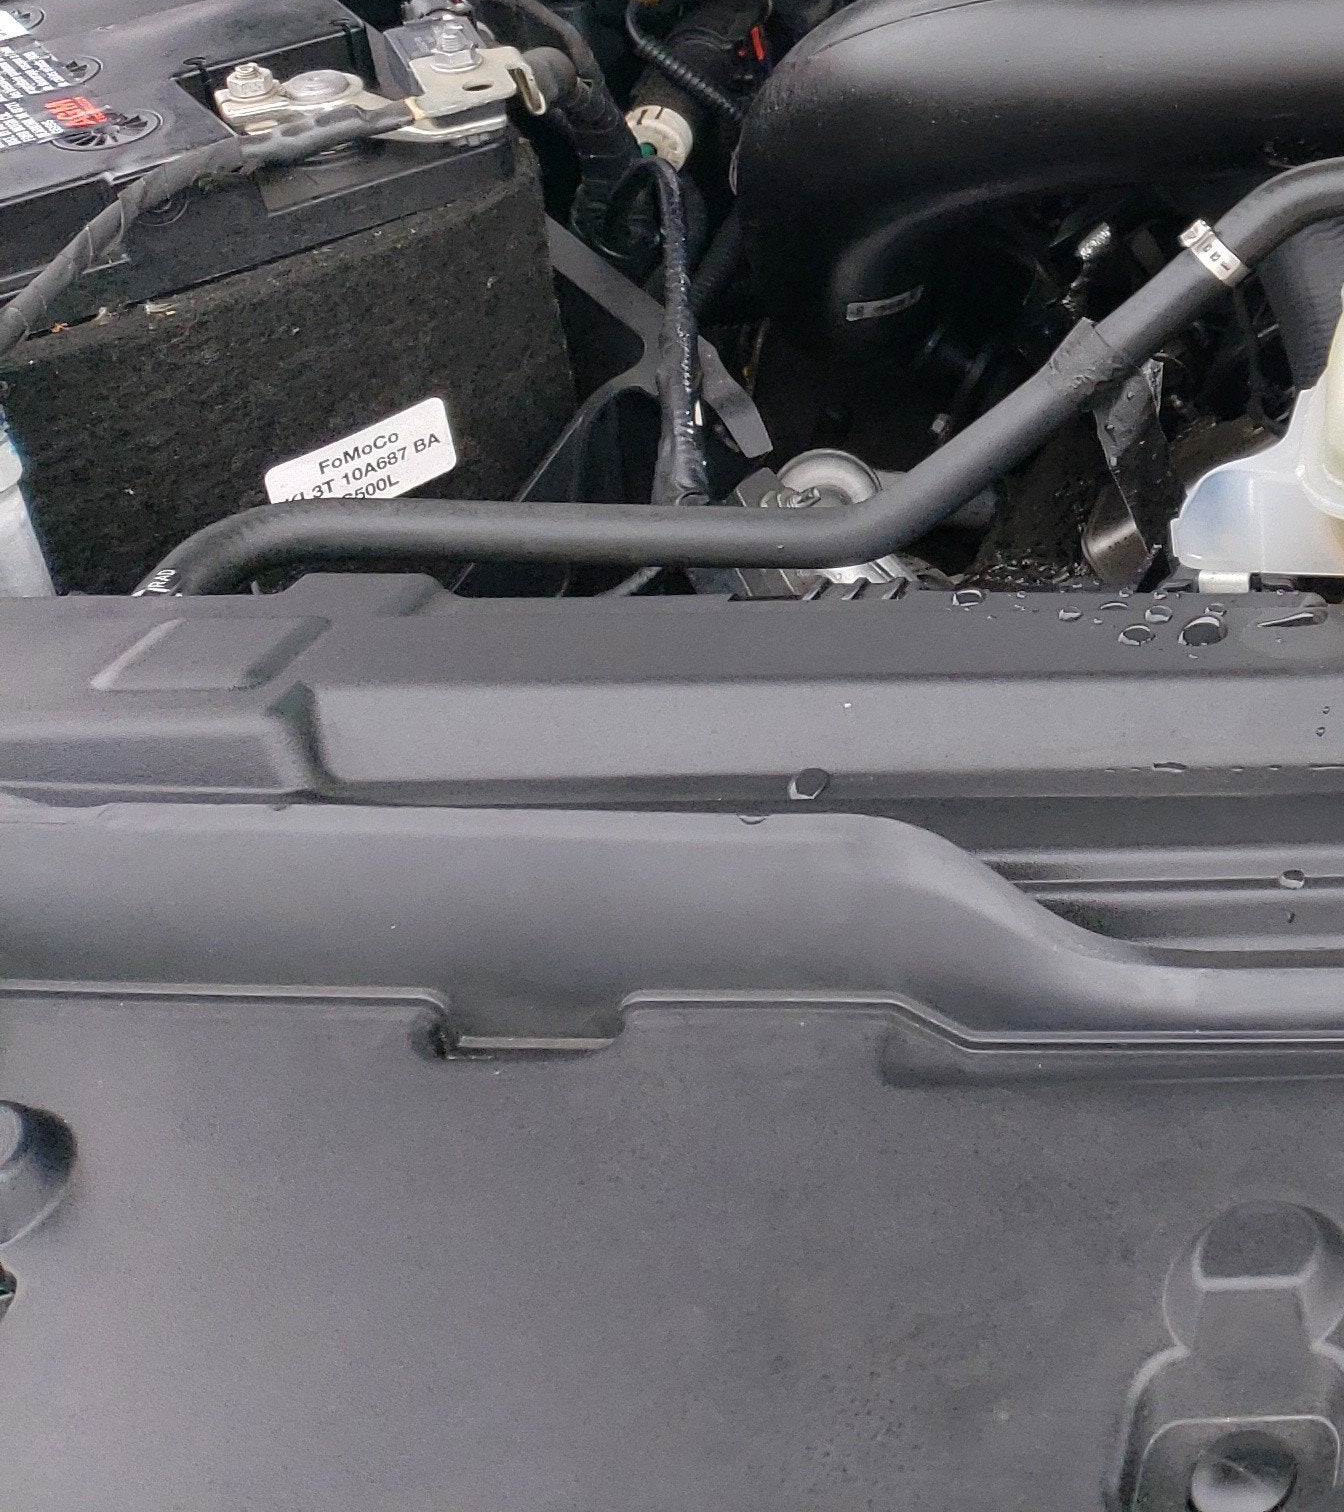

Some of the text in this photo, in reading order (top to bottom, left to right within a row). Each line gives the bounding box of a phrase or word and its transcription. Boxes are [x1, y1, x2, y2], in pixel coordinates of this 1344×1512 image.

[318, 432, 399, 475] FoMoCo
[341, 446, 408, 486] 10A687
[413, 433, 442, 454] BA
